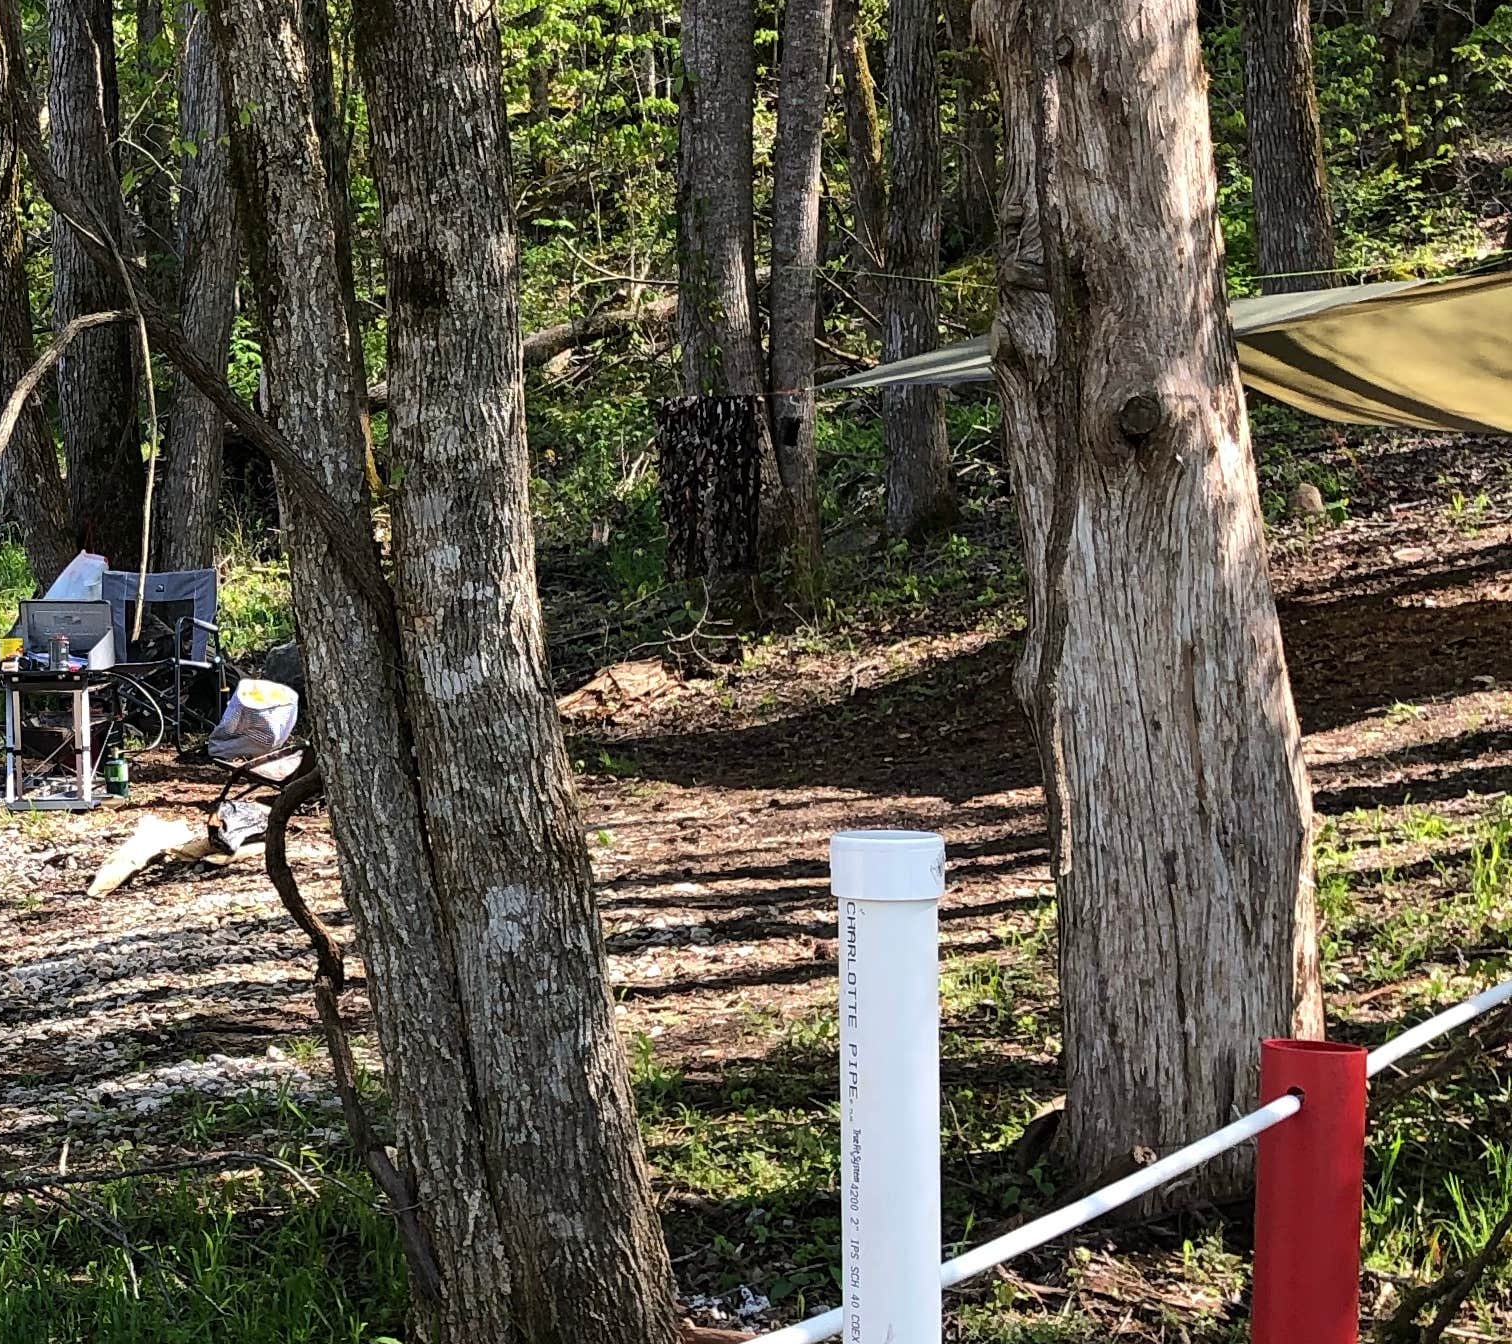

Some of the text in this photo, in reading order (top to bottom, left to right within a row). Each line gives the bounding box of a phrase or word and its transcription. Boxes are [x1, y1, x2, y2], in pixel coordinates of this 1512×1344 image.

[847, 902, 857, 1029] CHARLOTTE
[848, 1044, 858, 1099] PIPE
[850, 1184, 859, 1211] 4200
[851, 1240, 860, 1260] IPS
[851, 1266, 860, 1288] SCH
[851, 1294, 860, 1308] 40
[851, 1314, 861, 1343] COEX
